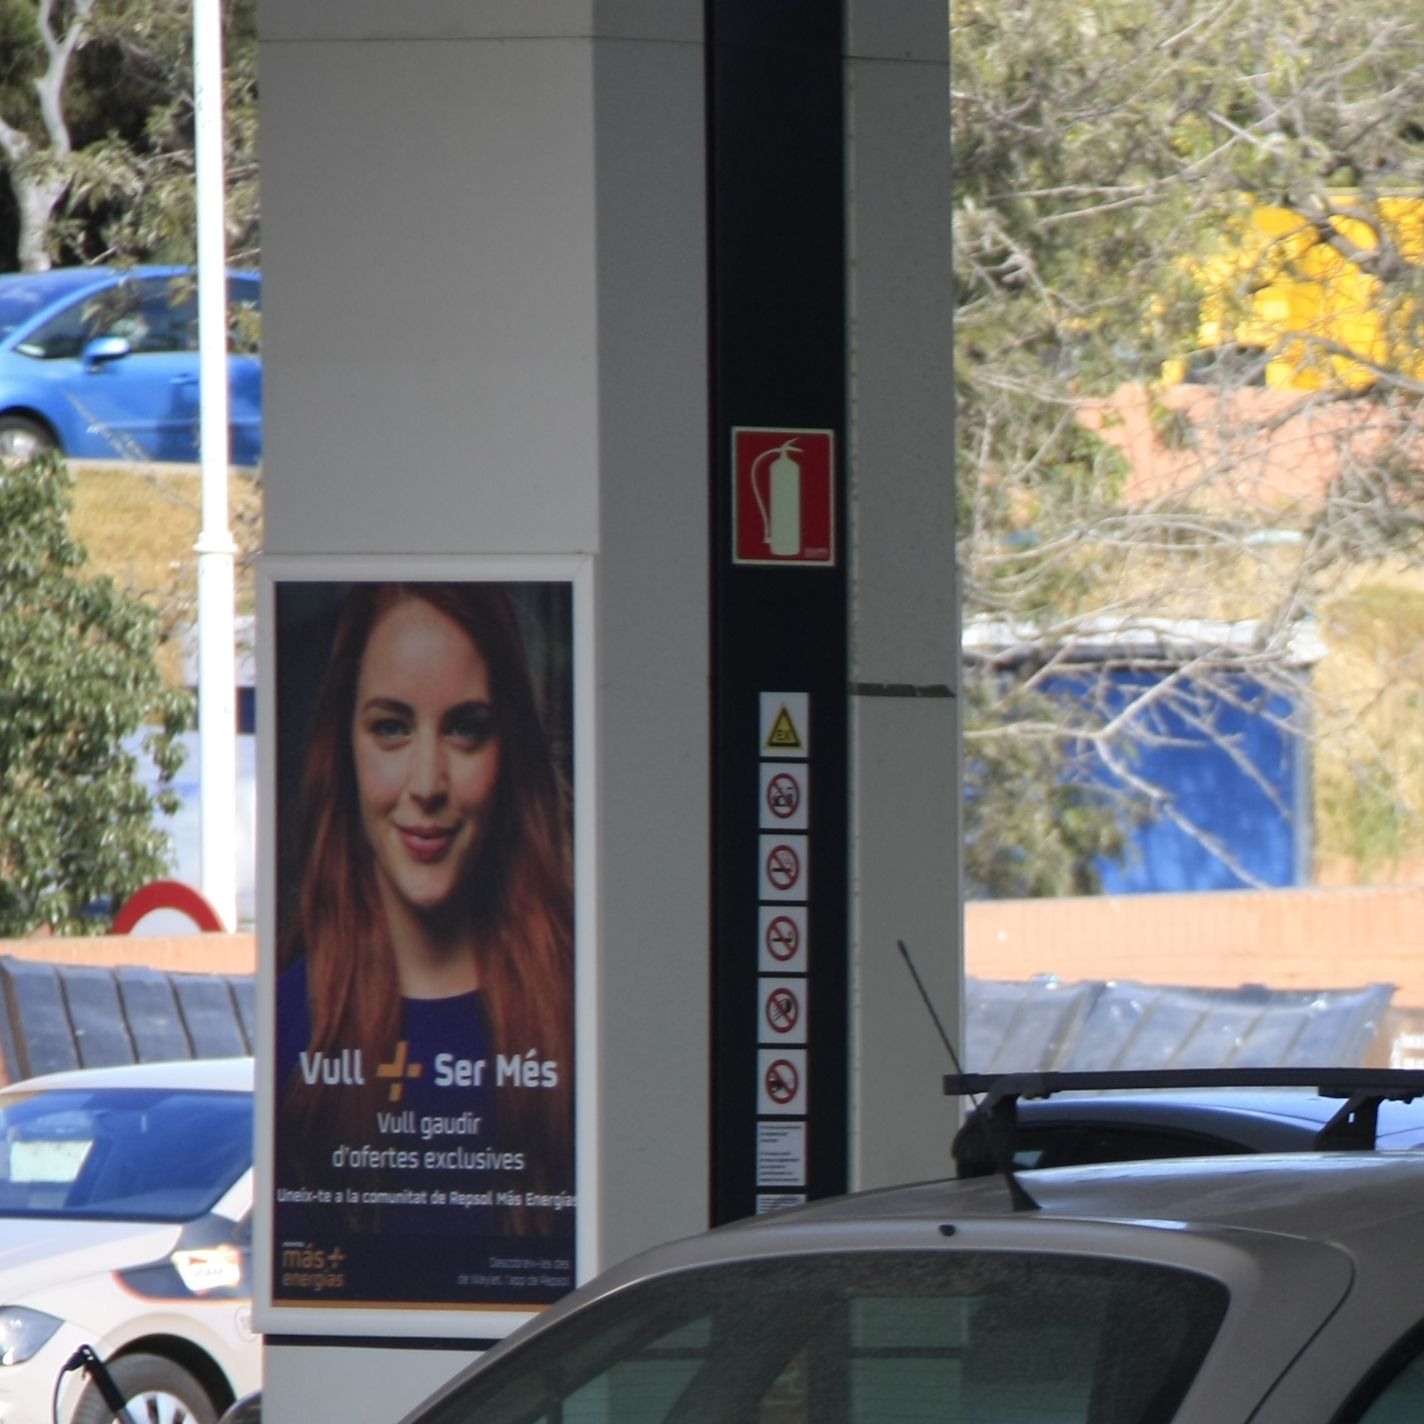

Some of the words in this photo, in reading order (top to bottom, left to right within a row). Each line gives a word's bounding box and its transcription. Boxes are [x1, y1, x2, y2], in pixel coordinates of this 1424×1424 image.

[299, 1050, 364, 1086] Vull
[433, 1054, 486, 1088] Ser
[495, 1049, 559, 1088] Més
[376, 1112, 415, 1135] Vull
[420, 1112, 481, 1140] gaudir
[332, 1145, 419, 1168] d'ofertes
[423, 1147, 526, 1170] exclusives
[277, 1188, 332, 1203] Uneix-te
[335, 1193, 343, 1203] a
[347, 1189, 359, 1204] la
[362, 1190, 427, 1205] comunitat
[430, 1191, 444, 1205] de
[448, 1192, 493, 1209] Repsol
[495, 1190, 521, 1206] Más
[282, 1242, 325, 1269] más
[282, 1270, 345, 1292] energías
